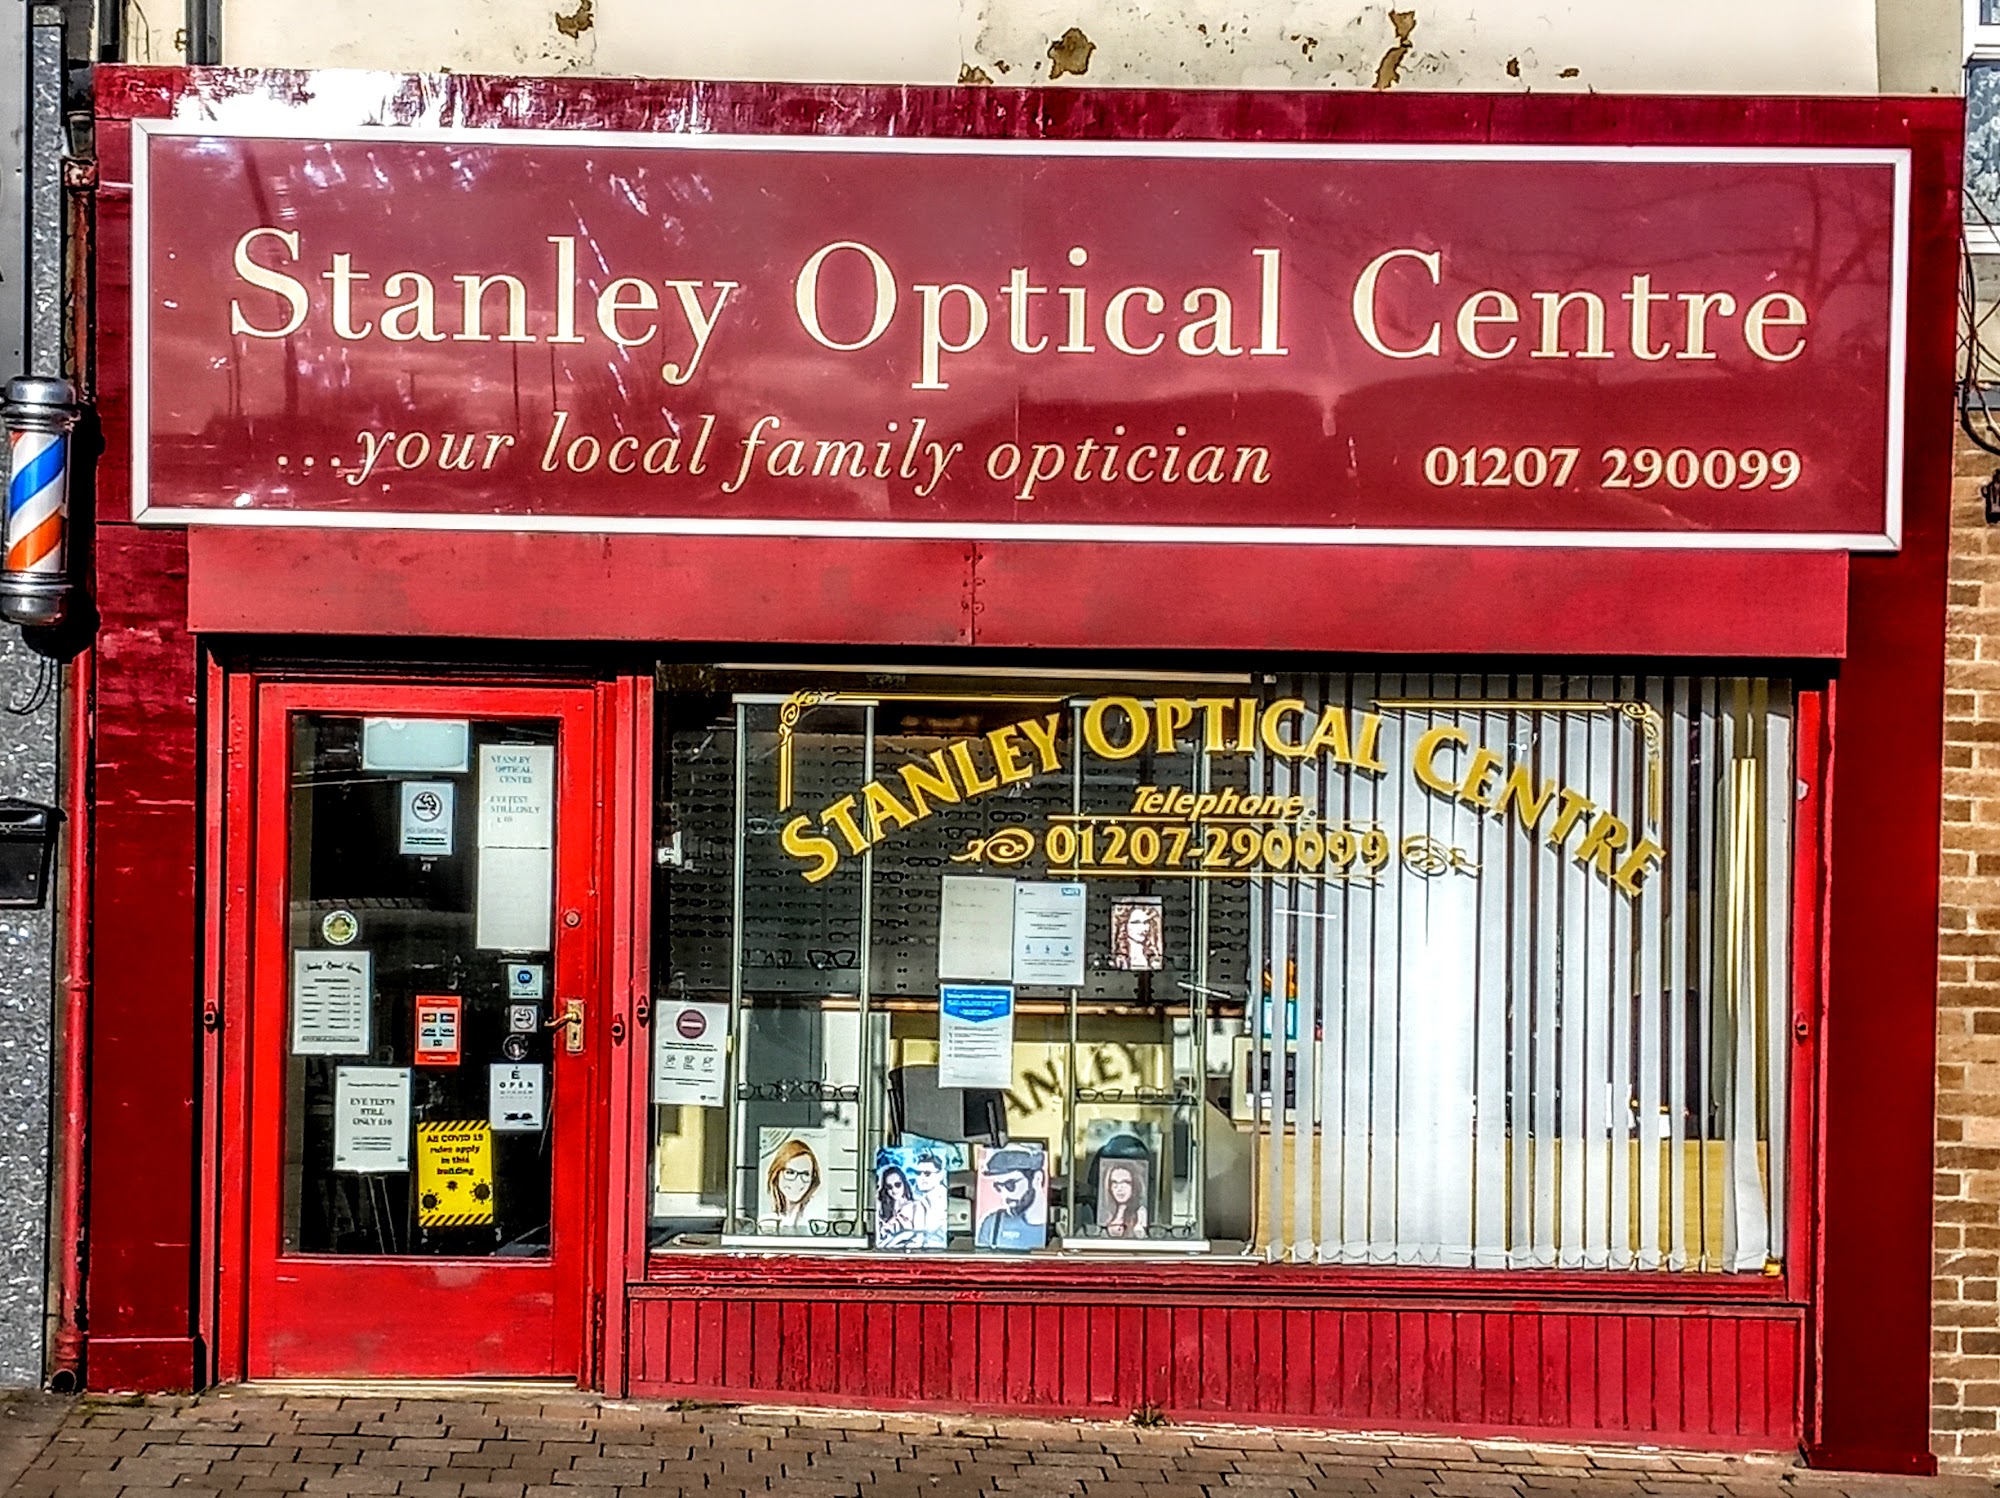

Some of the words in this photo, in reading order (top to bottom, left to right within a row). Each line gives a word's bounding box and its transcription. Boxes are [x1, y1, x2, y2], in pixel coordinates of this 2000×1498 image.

[231, 227, 738, 386] Stanley
[796, 240, 1290, 390] Optical
[1351, 249, 1808, 362] Centre
[541, 412, 715, 474] local
[721, 416, 962, 497] family
[986, 425, 1272, 500] optician
[1424, 447, 1580, 487] 01207
[1602, 448, 1801, 490] 290099
[780, 714, 1062, 882] STANLEY
[1083, 696, 1384, 774] OPTICAL
[1412, 726, 1664, 896] CENTRE
[1045, 824, 1391, 870] 01207-290099
